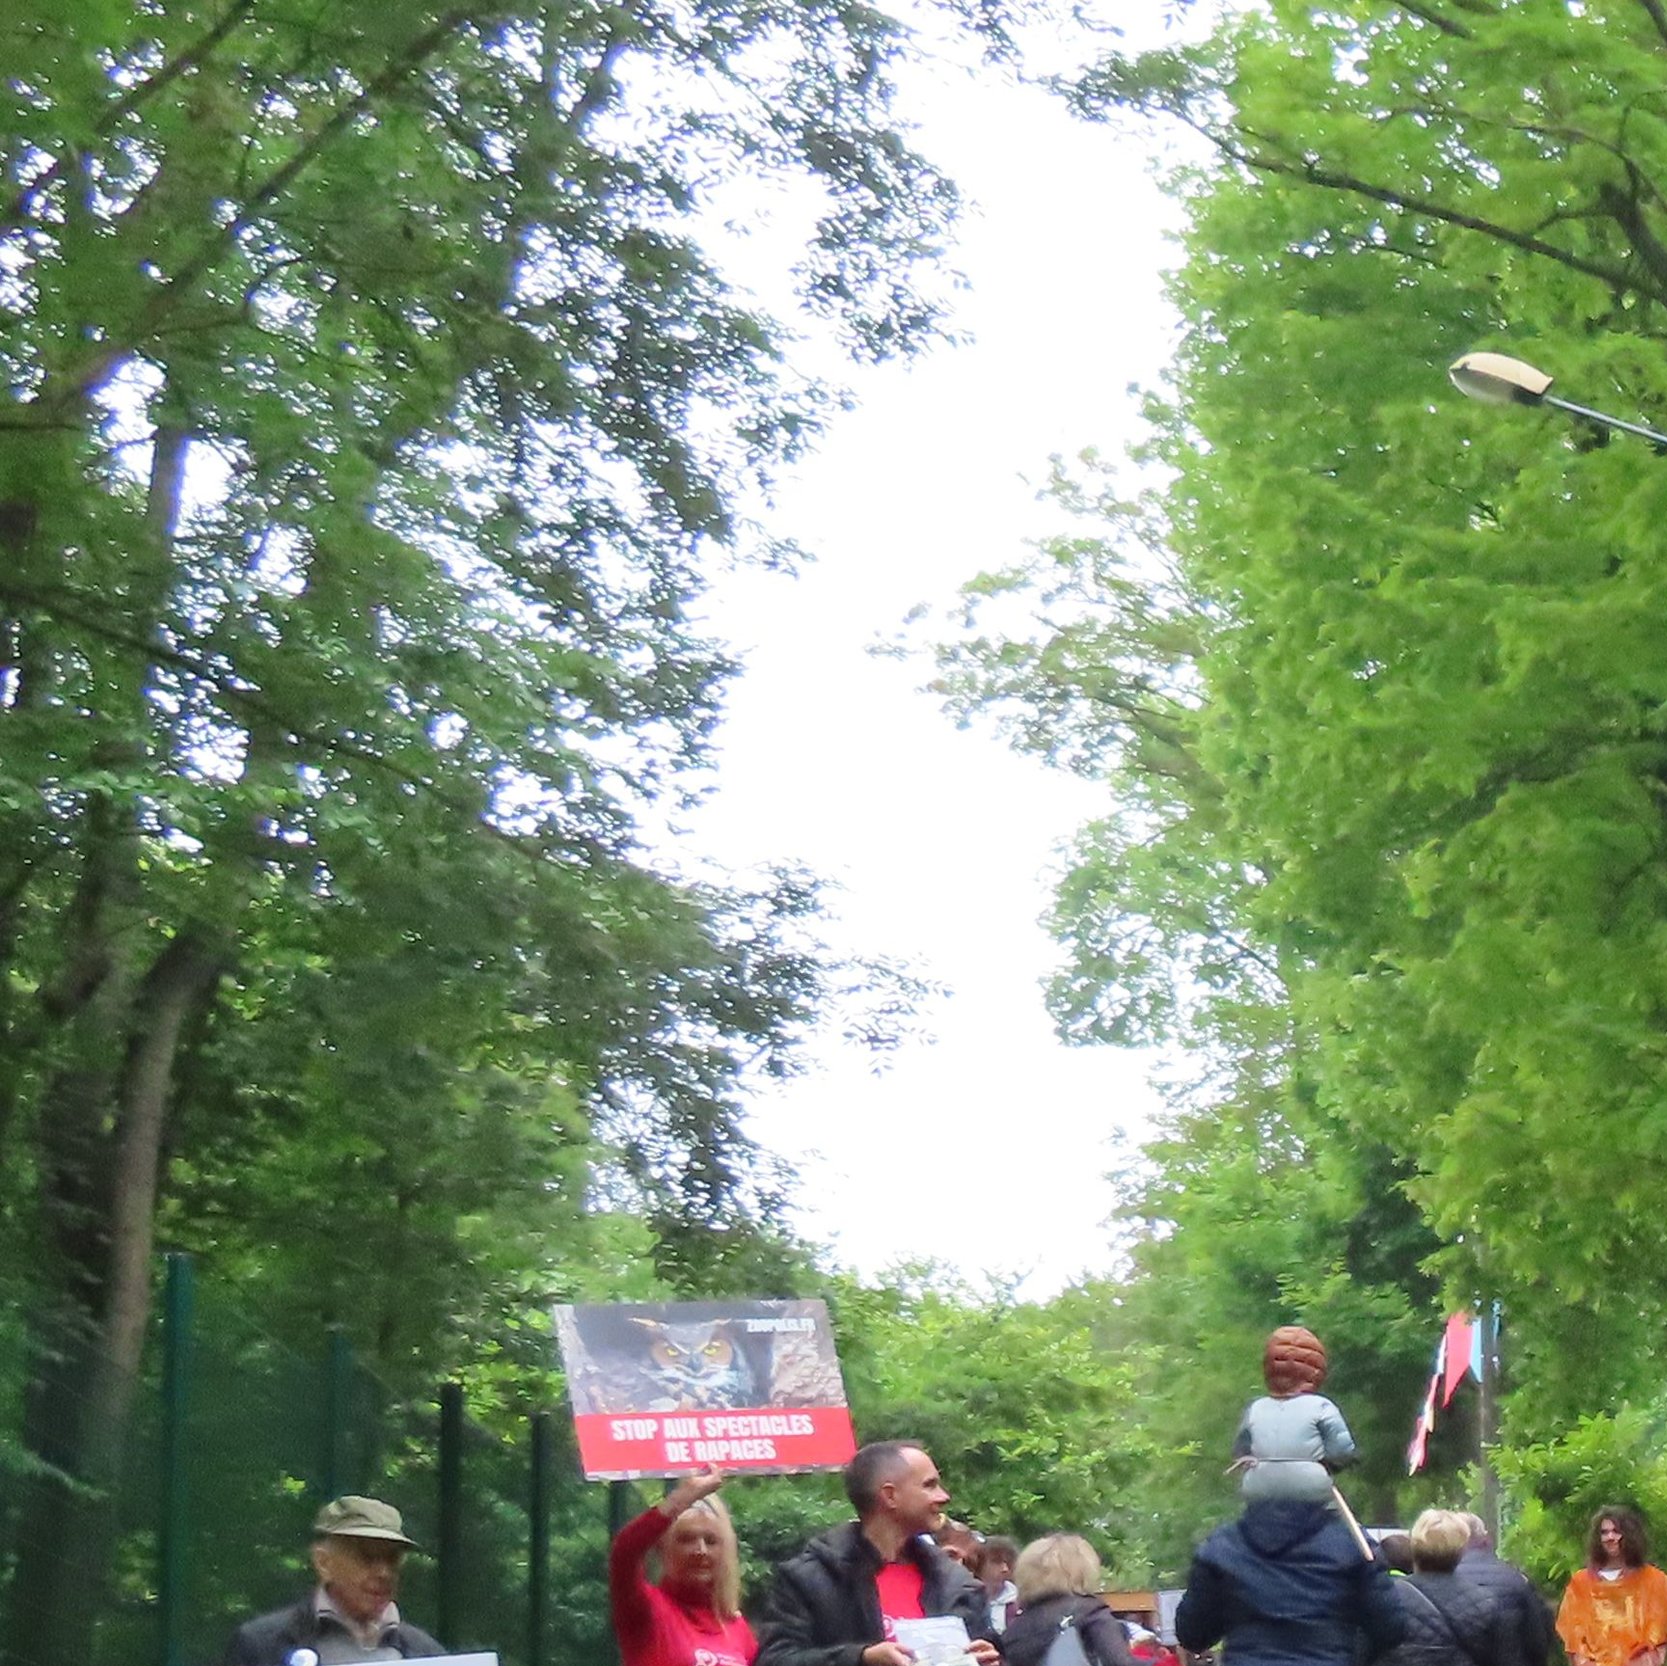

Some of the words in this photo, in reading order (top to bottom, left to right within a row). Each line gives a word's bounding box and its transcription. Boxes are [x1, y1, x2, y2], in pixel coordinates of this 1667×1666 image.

[611, 1419, 658, 1441] STOP
[663, 1417, 701, 1439] AUX
[703, 1414, 815, 1437] SPECTACLES
[664, 1441, 693, 1462] DE
[693, 1438, 777, 1461] RAPACES
